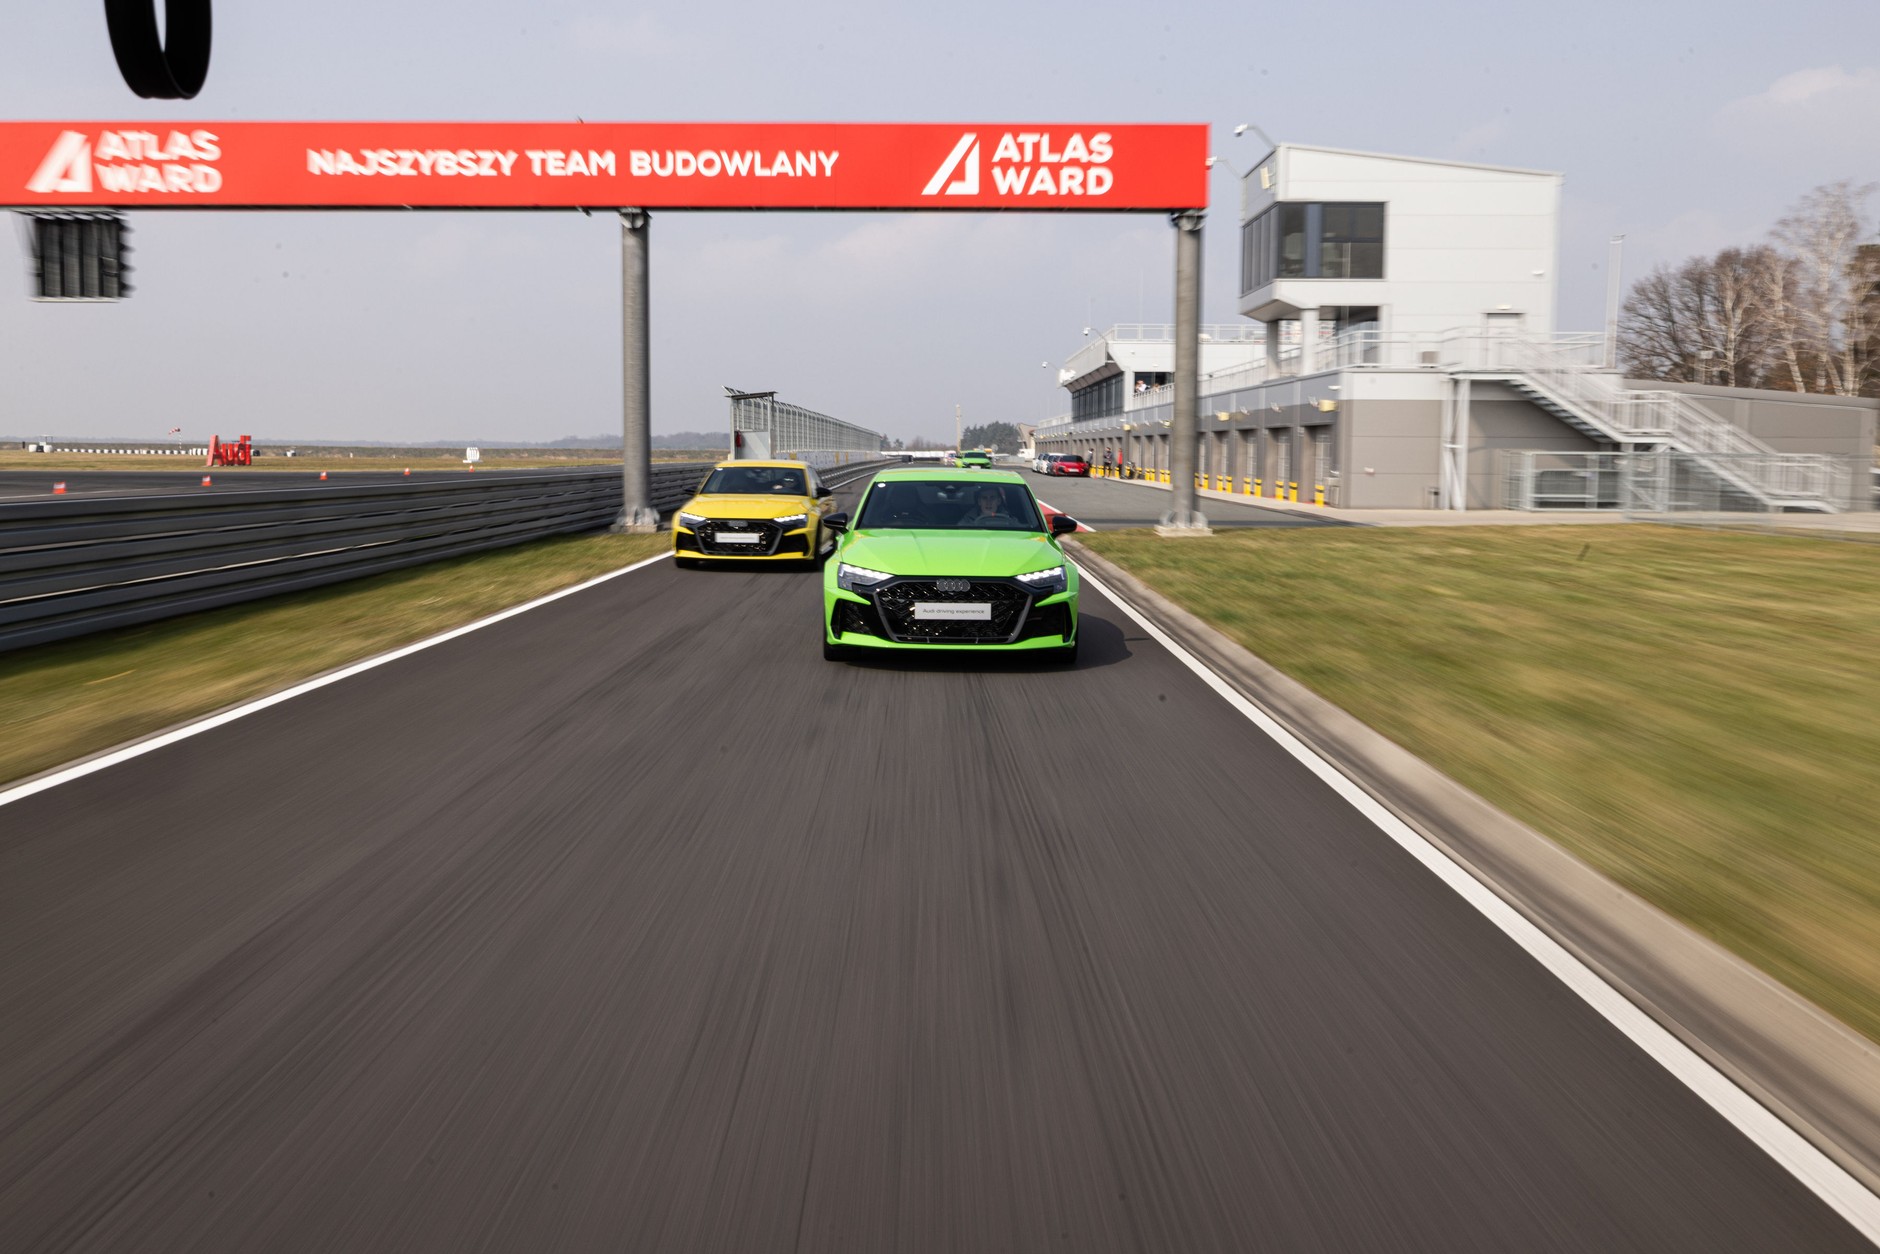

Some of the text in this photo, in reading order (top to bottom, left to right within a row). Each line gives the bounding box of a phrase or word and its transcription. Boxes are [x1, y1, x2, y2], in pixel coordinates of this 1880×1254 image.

[94, 129, 223, 162] ATLAS
[991, 132, 1114, 163] ATLAS
[94, 163, 223, 194] WARD
[306, 148, 840, 178] NAJSZYBSZY TEAM BUDOWLANY
[991, 165, 1114, 196] WARD
[207, 435, 252, 466] Audi
